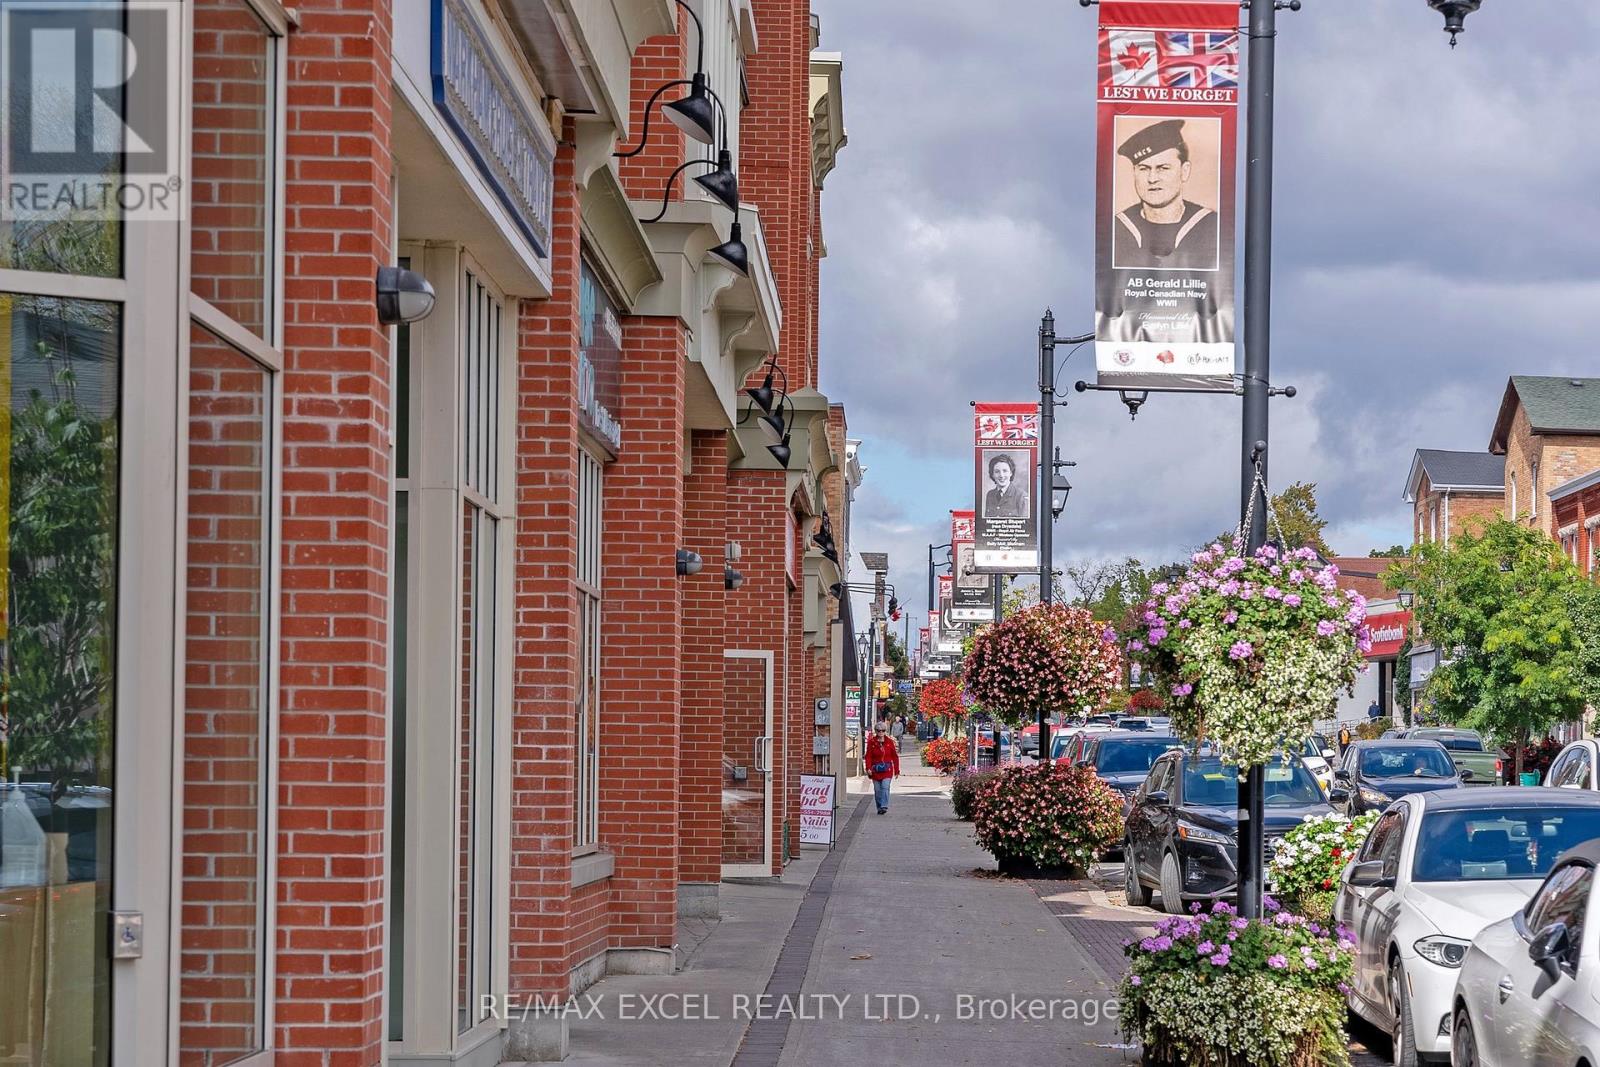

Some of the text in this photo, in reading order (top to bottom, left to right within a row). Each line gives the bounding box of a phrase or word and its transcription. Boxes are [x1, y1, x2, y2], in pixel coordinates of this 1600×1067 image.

[1103, 86, 1234, 101] LEST WE FORGET
[1127, 278, 1207, 289] AB Gerald Lillie
[1124, 289, 1207, 299] Royal Canadian Navy
[1156, 299, 1177, 307] WWII
[800, 796, 818, 808] pa
